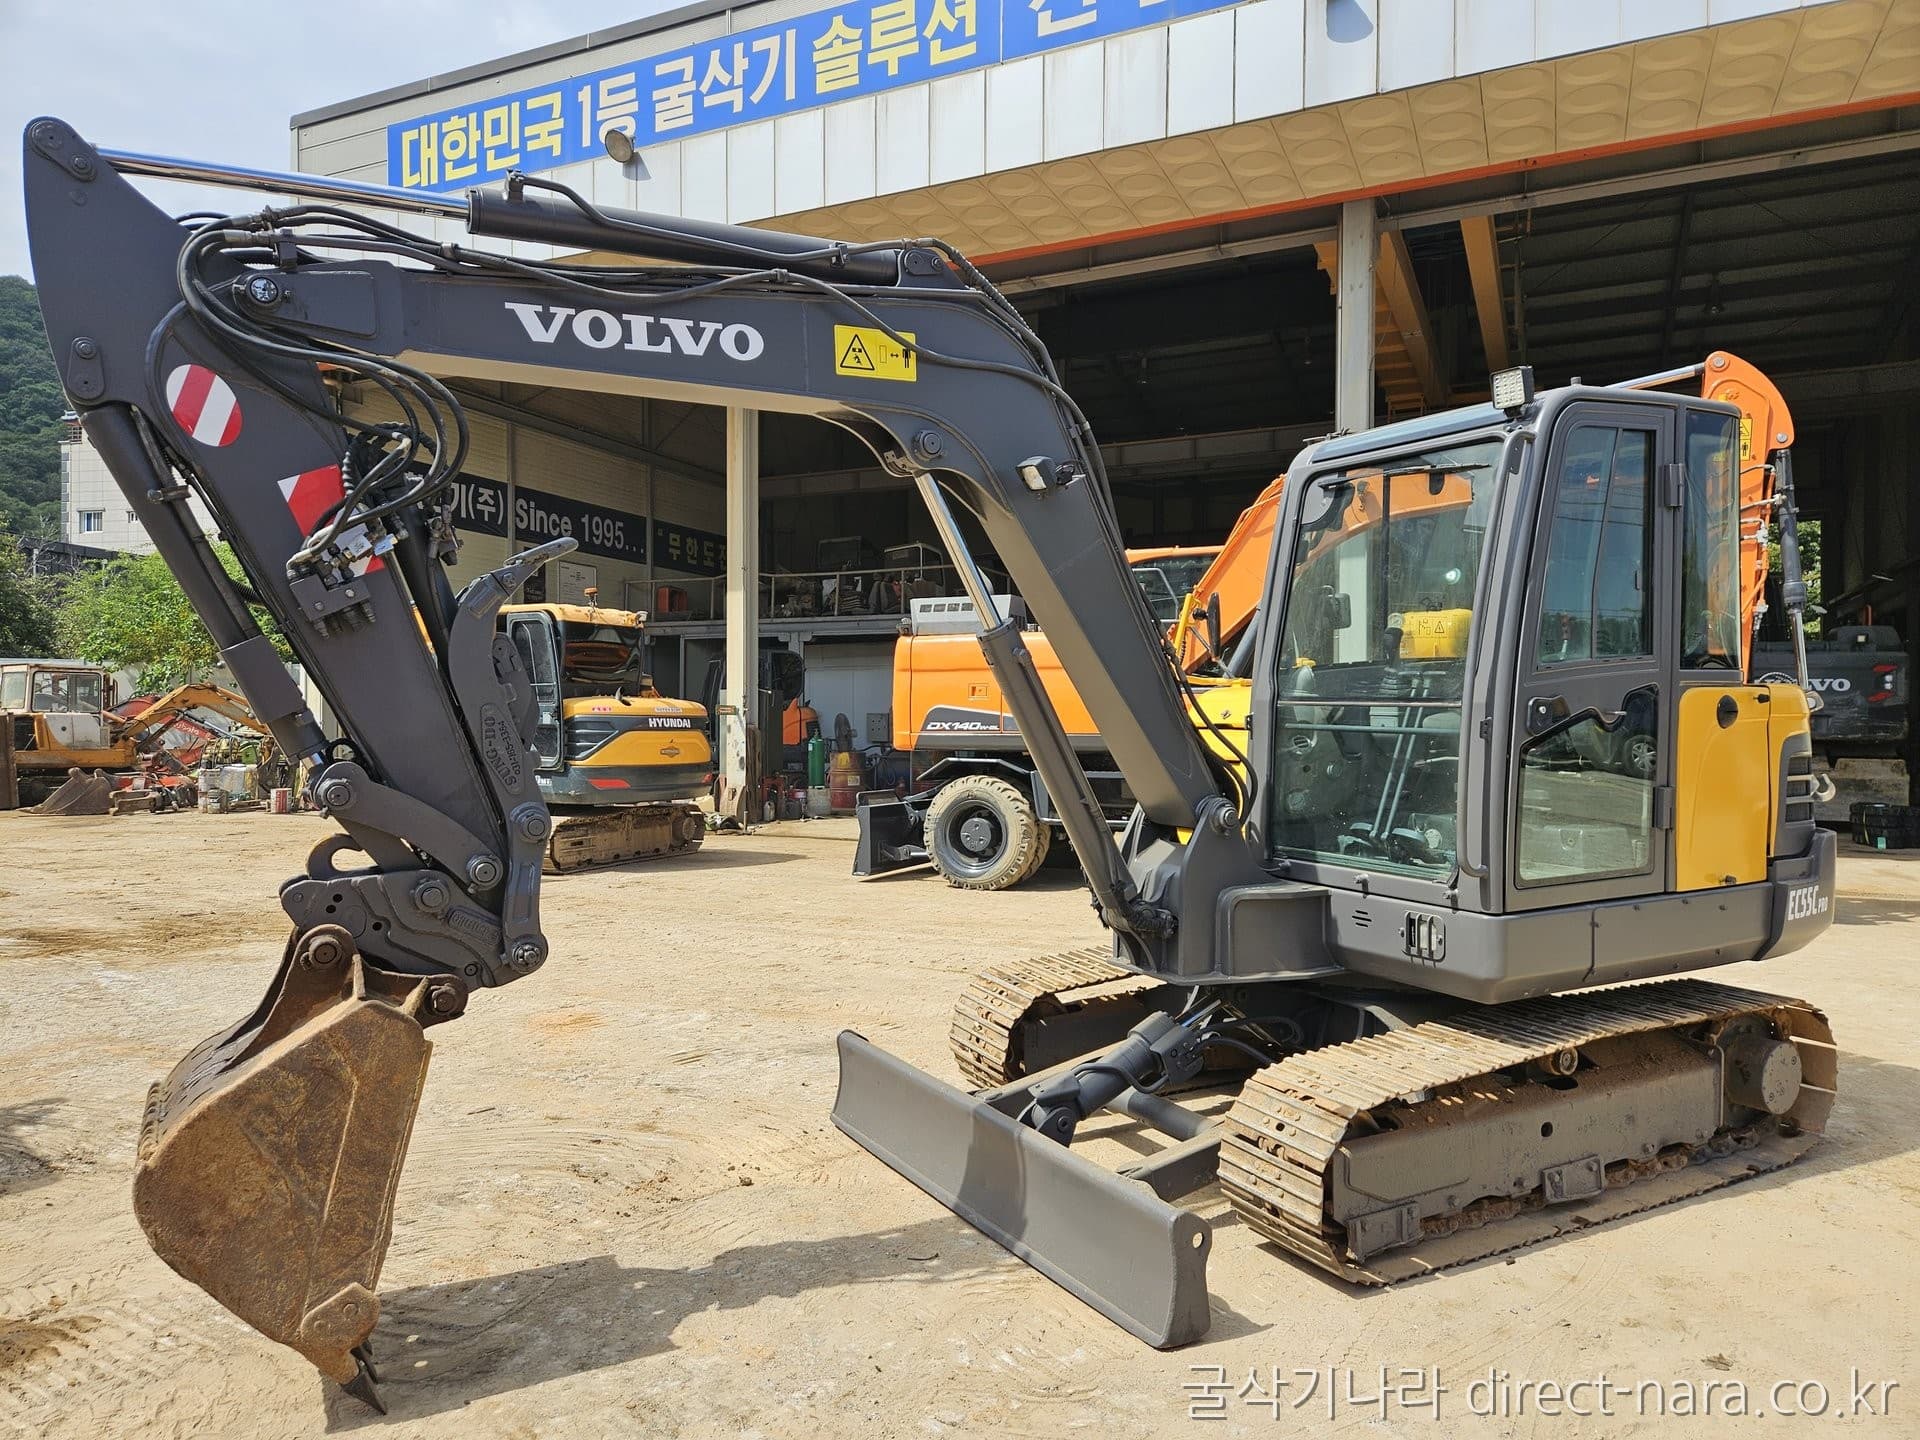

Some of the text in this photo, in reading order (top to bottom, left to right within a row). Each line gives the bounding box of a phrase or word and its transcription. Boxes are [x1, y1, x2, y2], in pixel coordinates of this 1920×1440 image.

[402, 0, 977, 188] 대한민국 1등 굴삭기 솔루션
[504, 301, 765, 361] VOLVO
[515, 498, 572, 537] Since
[648, 718, 691, 729] HYUNDAI
[1787, 885, 1820, 921] EC55C
